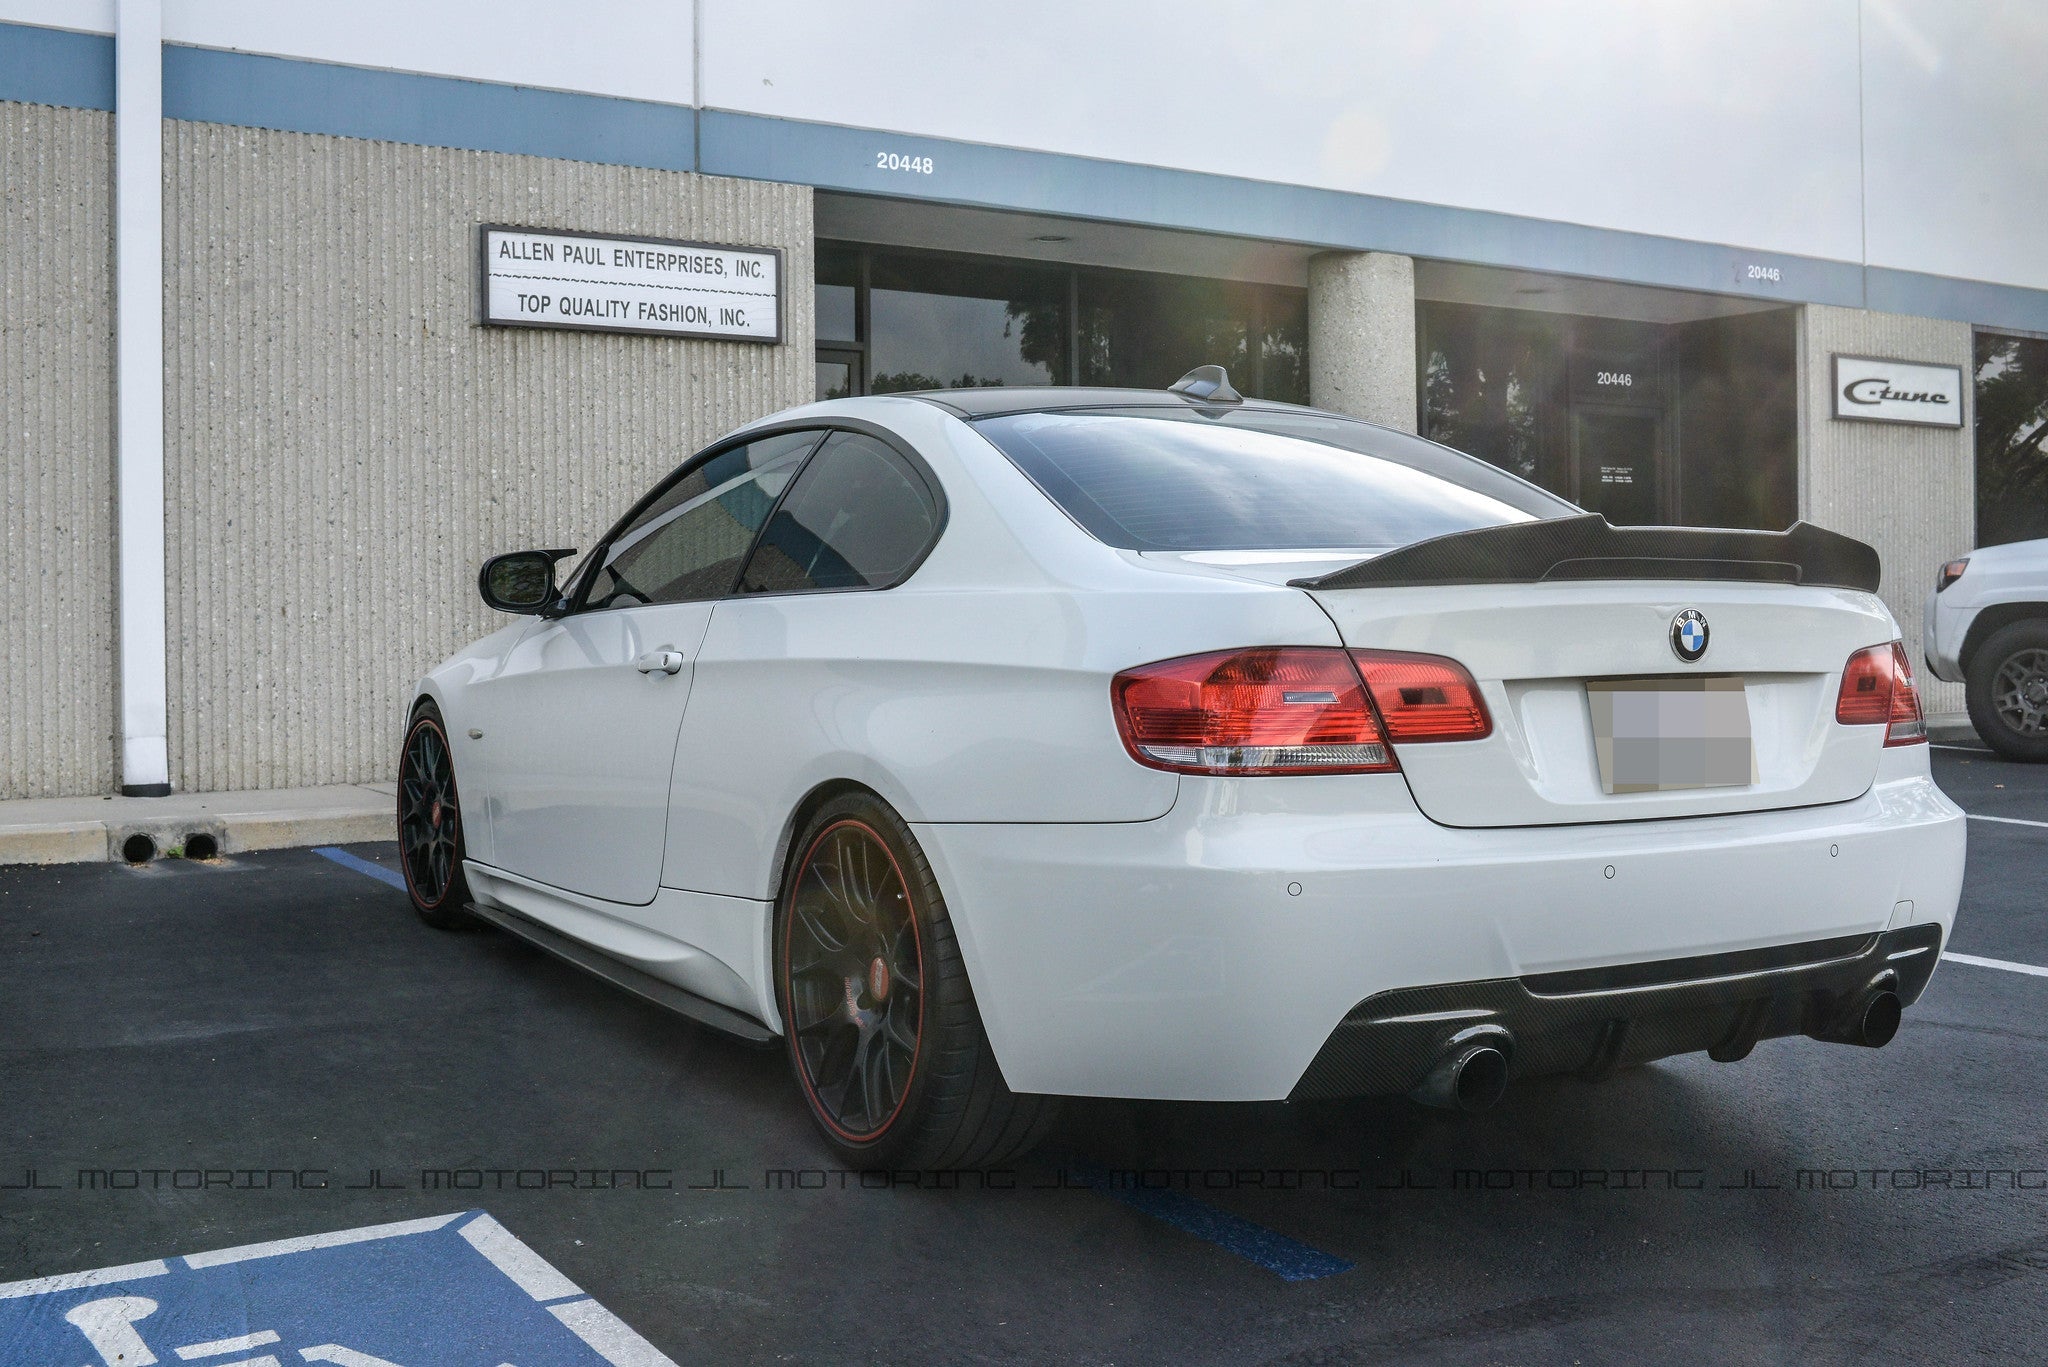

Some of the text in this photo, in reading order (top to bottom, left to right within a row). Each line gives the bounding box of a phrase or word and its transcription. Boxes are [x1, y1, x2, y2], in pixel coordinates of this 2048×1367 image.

[877, 152, 933, 175] 20448
[499, 240, 765, 279] ALLEN PAUL ENTERPRISES, INC.
[1748, 265, 1780, 281] 20446
[517, 293, 750, 328] TOP QUALITY FASHION, INC.
[1597, 371, 1632, 386] 20446
[1676, 610, 1707, 628] BMW
